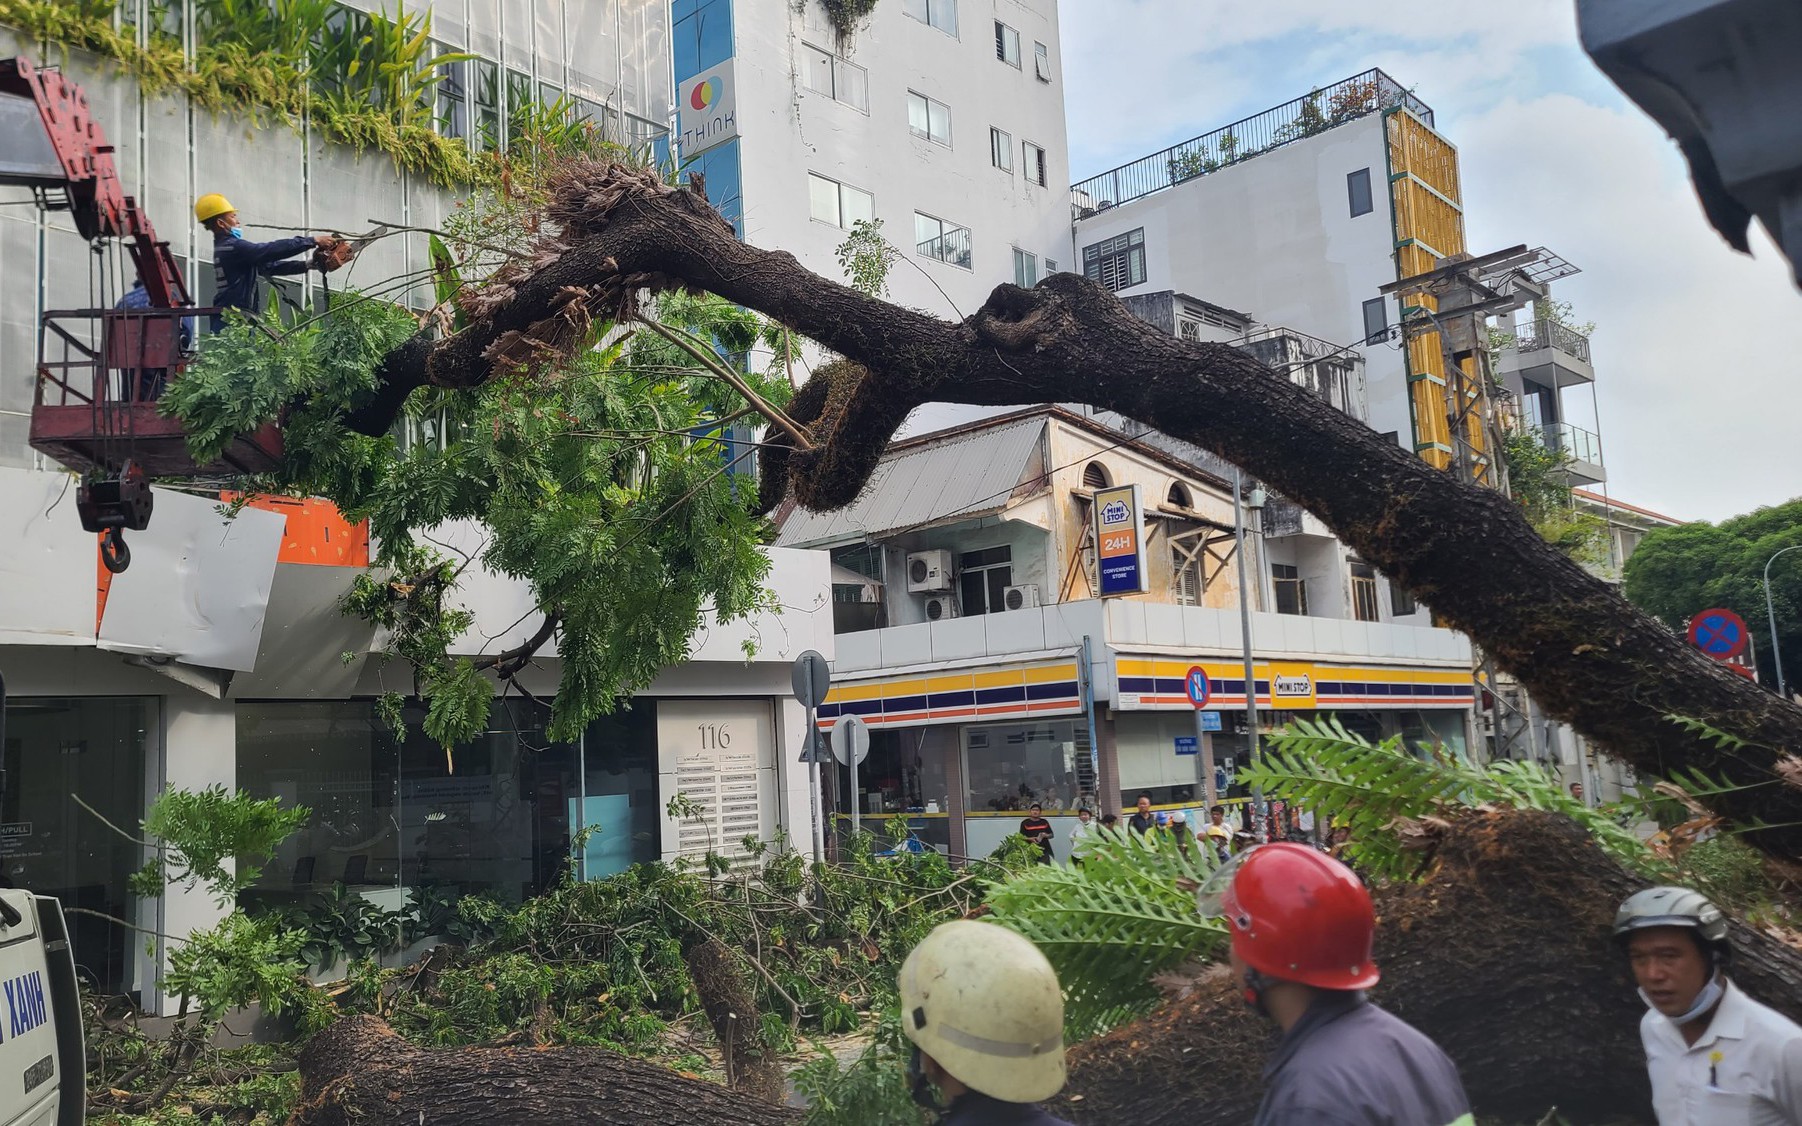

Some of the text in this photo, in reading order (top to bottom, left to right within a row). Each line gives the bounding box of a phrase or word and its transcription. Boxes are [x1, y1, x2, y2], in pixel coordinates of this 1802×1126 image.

[684, 110, 735, 147] THINK
[1106, 505, 1124, 515] MINI
[1106, 512, 1125, 522] STOP
[1104, 536, 1131, 551] 24H
[1103, 565, 1135, 575] CONVENIENCE
[1278, 682, 1308, 693] MINI STOP
[698, 722, 731, 750] 116
[3, 970, 47, 1040] XANH
